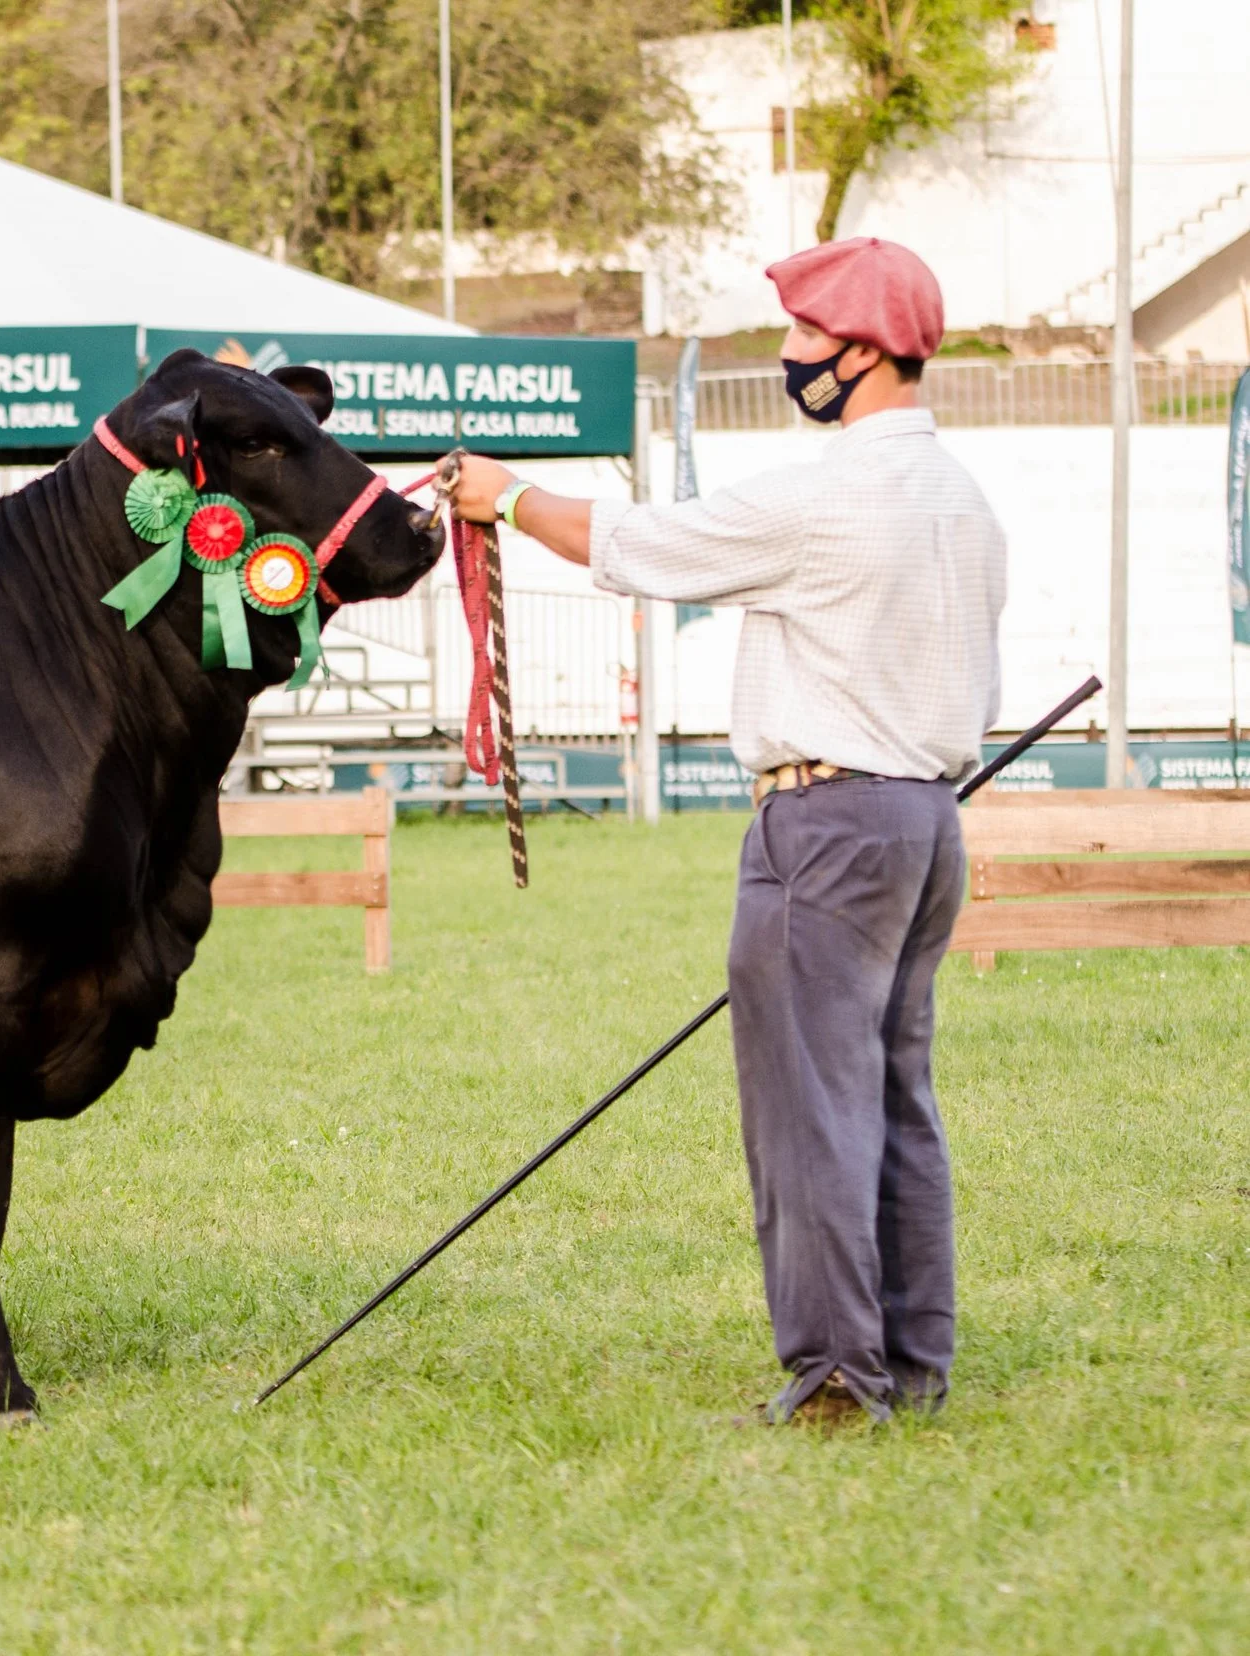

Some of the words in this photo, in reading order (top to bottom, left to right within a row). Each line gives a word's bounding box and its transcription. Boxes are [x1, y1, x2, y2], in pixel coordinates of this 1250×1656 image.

[304, 359, 450, 401] ISTEMA
[454, 364, 581, 403] FARSUL
[8, 401, 80, 428] RURAL
[384, 408, 455, 438] SENAR
[461, 410, 515, 438] CASA
[514, 411, 580, 438] RURAL
[664, 762, 740, 782] SSTEMA
[1000, 760, 1054, 779] ARSUL
